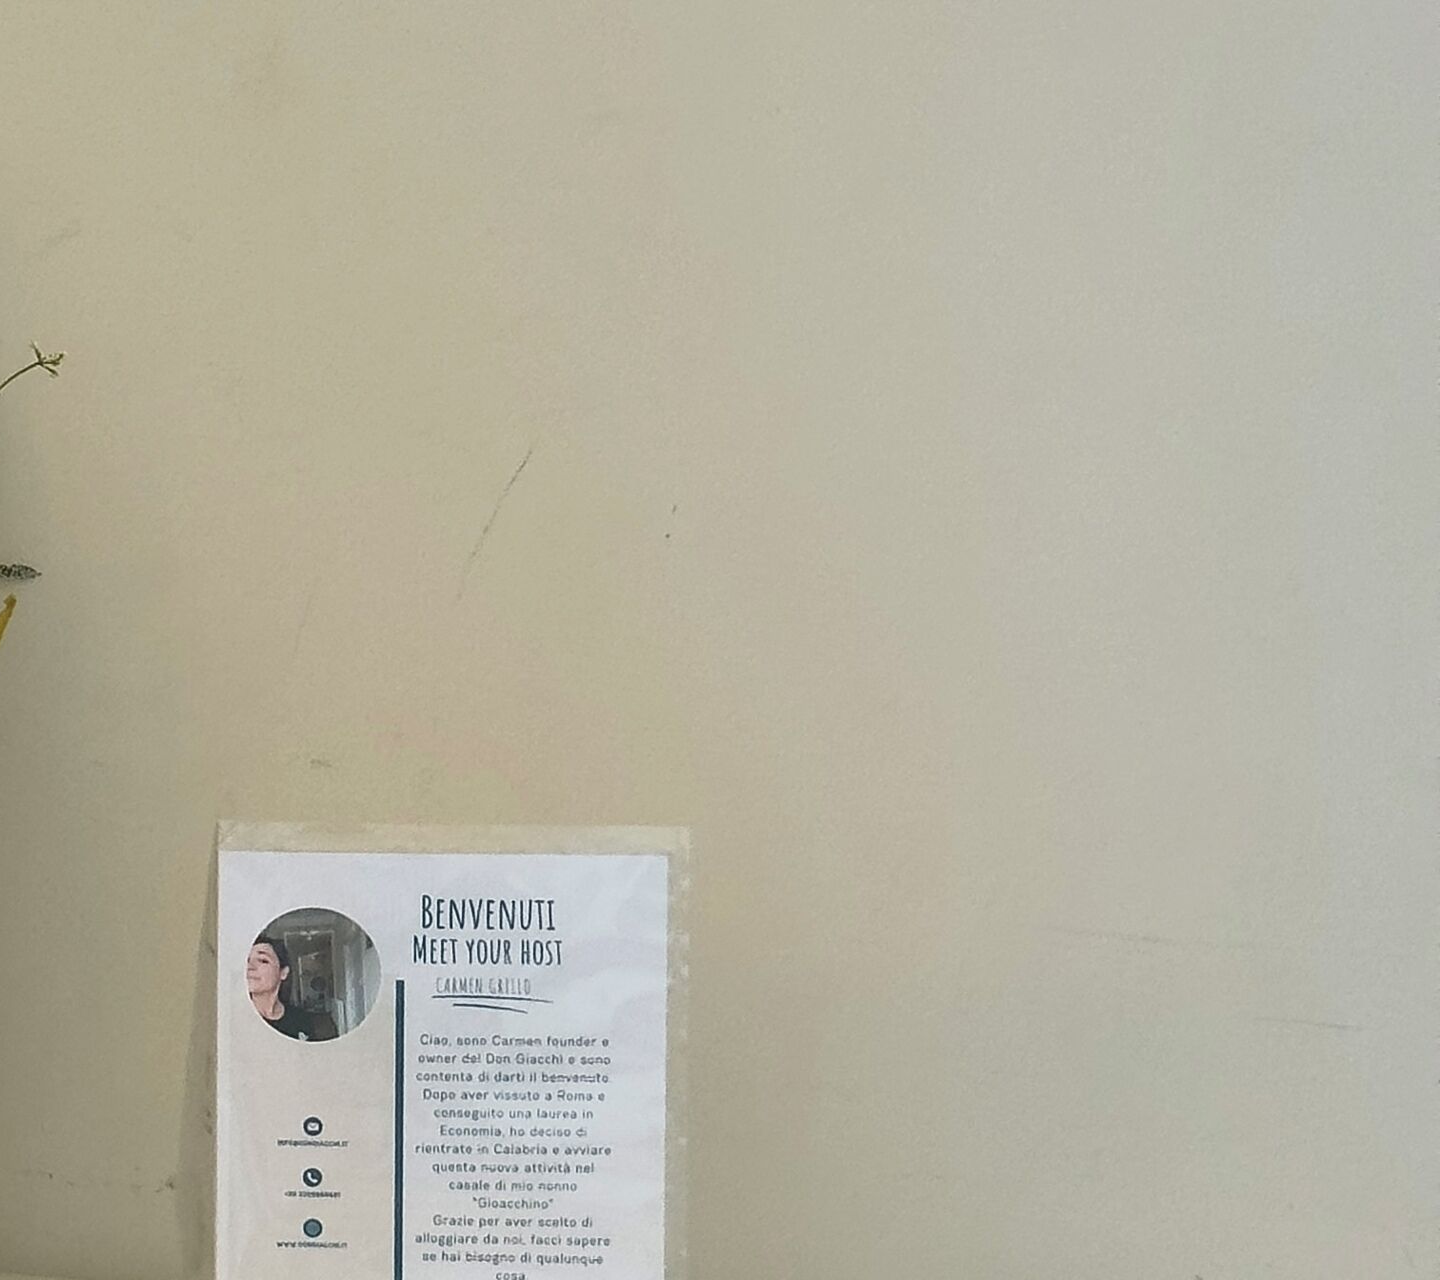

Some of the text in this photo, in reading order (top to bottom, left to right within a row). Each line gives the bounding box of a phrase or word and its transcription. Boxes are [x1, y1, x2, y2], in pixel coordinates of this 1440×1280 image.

[421, 894, 556, 932] BENVENUTI
[412, 934, 563, 966] MEET YOUR HOST
[435, 977, 483, 994] CARMEN
[419, 1033, 610, 1047] Ciao, sono Carmen founder e
[417, 1054, 457, 1064] owner
[461, 1053, 481, 1064] del
[486, 1053, 510, 1064] Don
[568, 1056, 576, 1065] e
[580, 1056, 611, 1066] sono
[415, 1071, 473, 1083] contenta
[478, 1071, 490, 1083] di
[494, 1071, 525, 1083] darti
[423, 1088, 606, 1103] Dopo aver vissuto a Roma e
[433, 1108, 594, 1121] conseguito una laurea in
[509, 1125, 525, 1137] ho
[529, 1125, 571, 1137] deciso
[575, 1125, 588, 1137] di
[414, 1143, 612, 1156] rientrato in Calabria e avviare
[432, 1161, 595, 1174] questa nuova attività nel
[448, 1179, 577, 1192] casale di mio nonno
[432, 1215, 593, 1230] Grazie per aver scelto di
[414, 1232, 479, 1247] alloggiare
[483, 1233, 499, 1245] da
[530, 1234, 562, 1246] facci
[566, 1236, 611, 1248] sapere
[422, 1250, 604, 1267] se hai bisogno di qualunque
